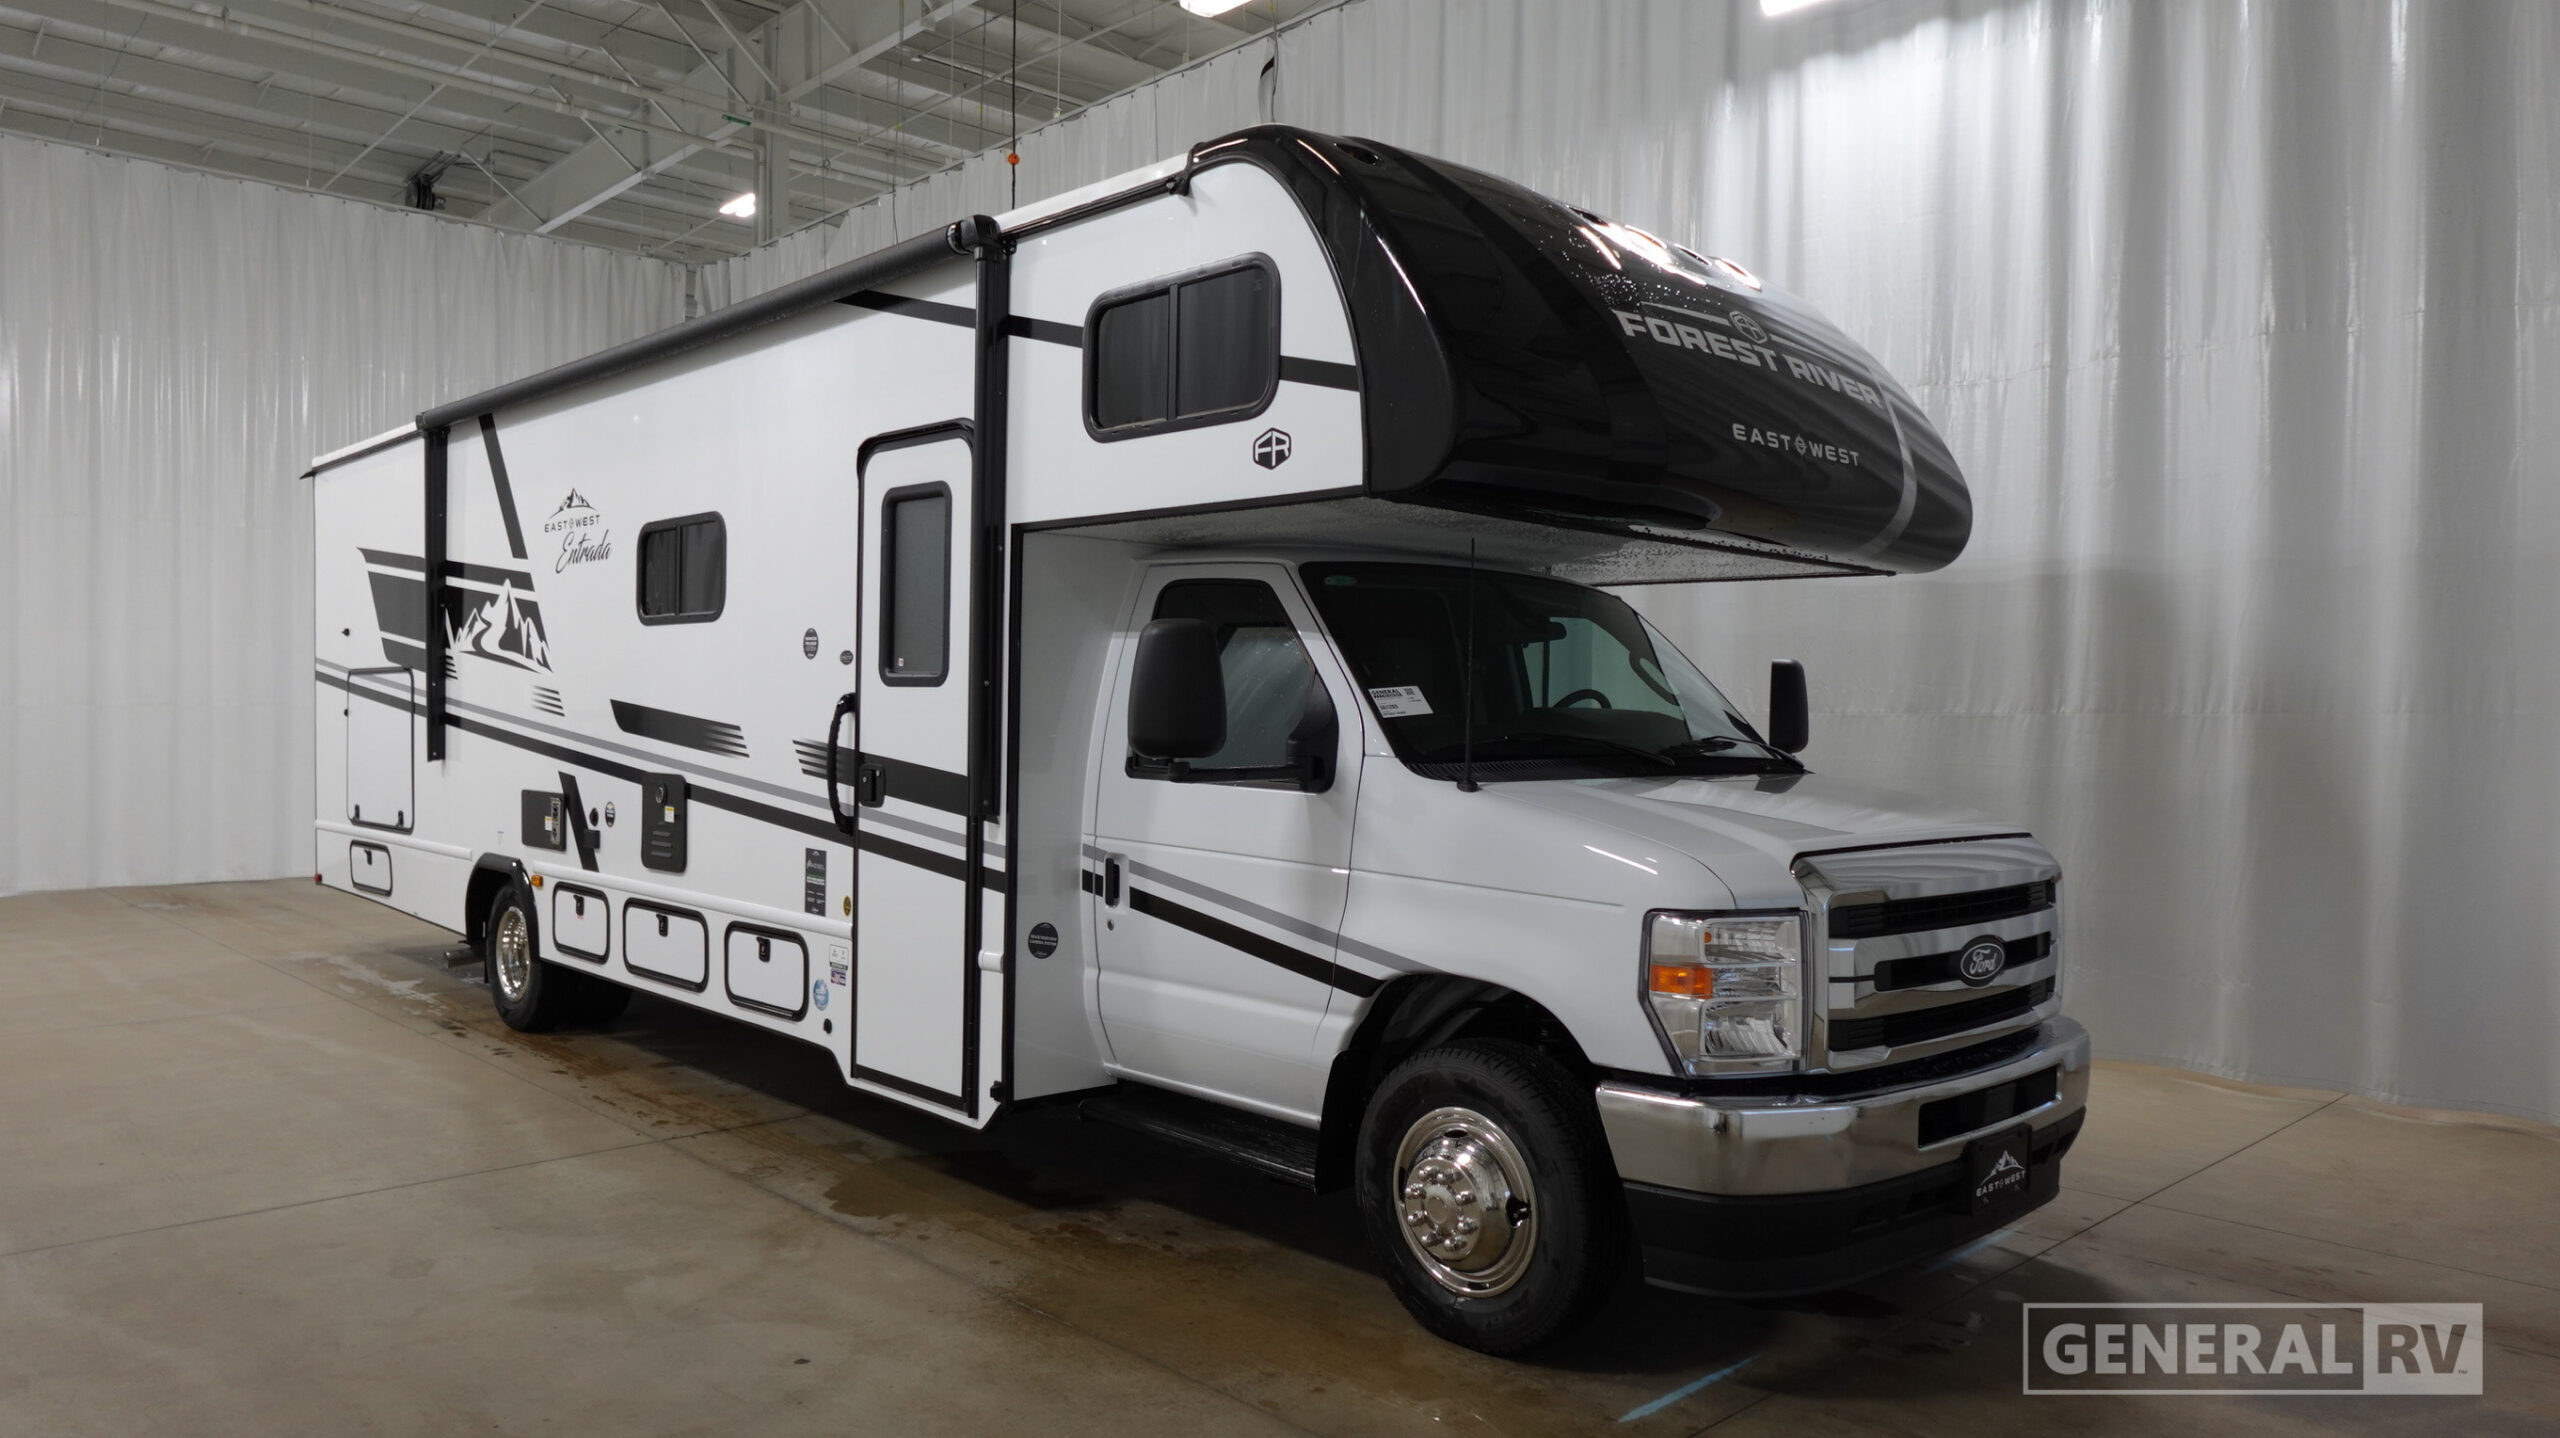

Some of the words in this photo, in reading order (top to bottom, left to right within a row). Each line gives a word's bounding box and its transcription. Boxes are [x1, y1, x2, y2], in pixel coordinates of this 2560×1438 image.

[1611, 309, 1778, 372] FOREST
[1781, 354, 1885, 409] RIVER
[1732, 423, 1791, 451] EAST
[1808, 440, 1860, 467] WEST
[544, 520, 568, 533] EAST
[575, 514, 600, 528] WEST
[555, 529, 613, 574] Entrada
[1969, 949, 1998, 975] Ford
[1976, 1180, 2000, 1197] EAST
[2004, 1170, 2026, 1185] WEST
